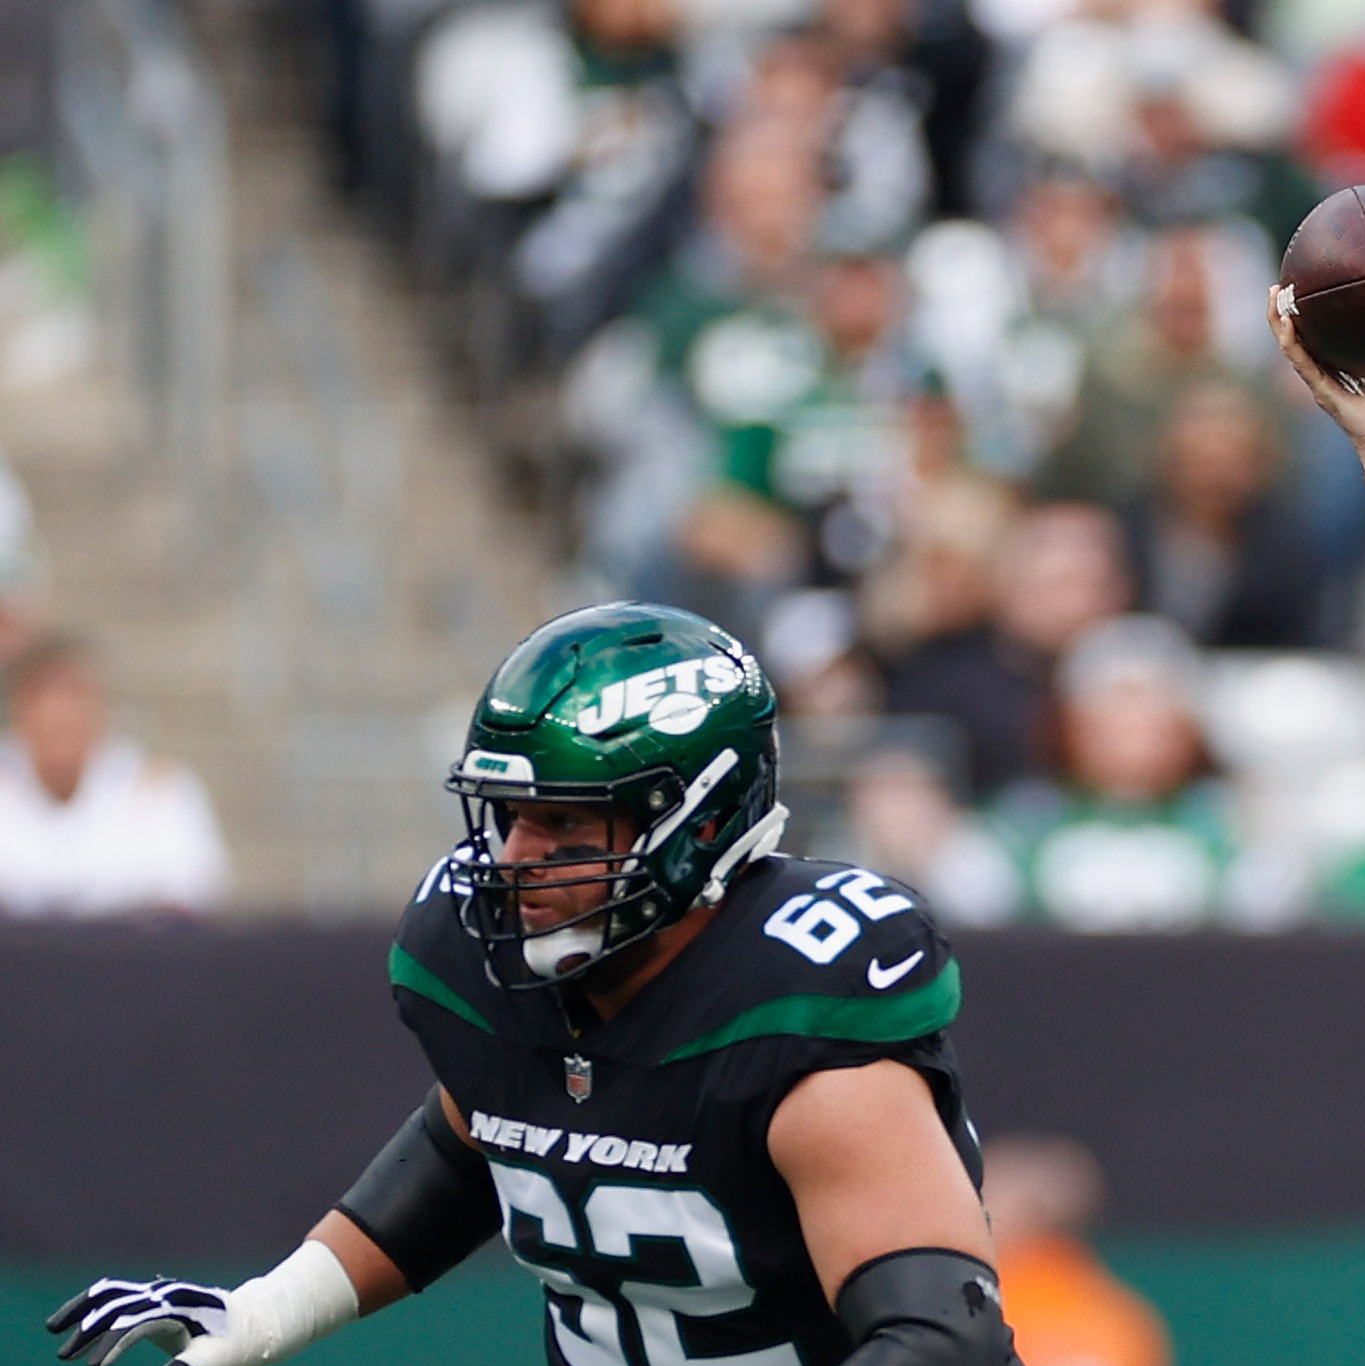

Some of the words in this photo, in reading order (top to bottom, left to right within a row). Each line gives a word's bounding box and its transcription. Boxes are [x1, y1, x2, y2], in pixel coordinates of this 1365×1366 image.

[576, 655, 740, 735] JETS
[762, 867, 915, 965] 62
[469, 1110, 562, 1157] NEW
[563, 1132, 692, 1173] YORK
